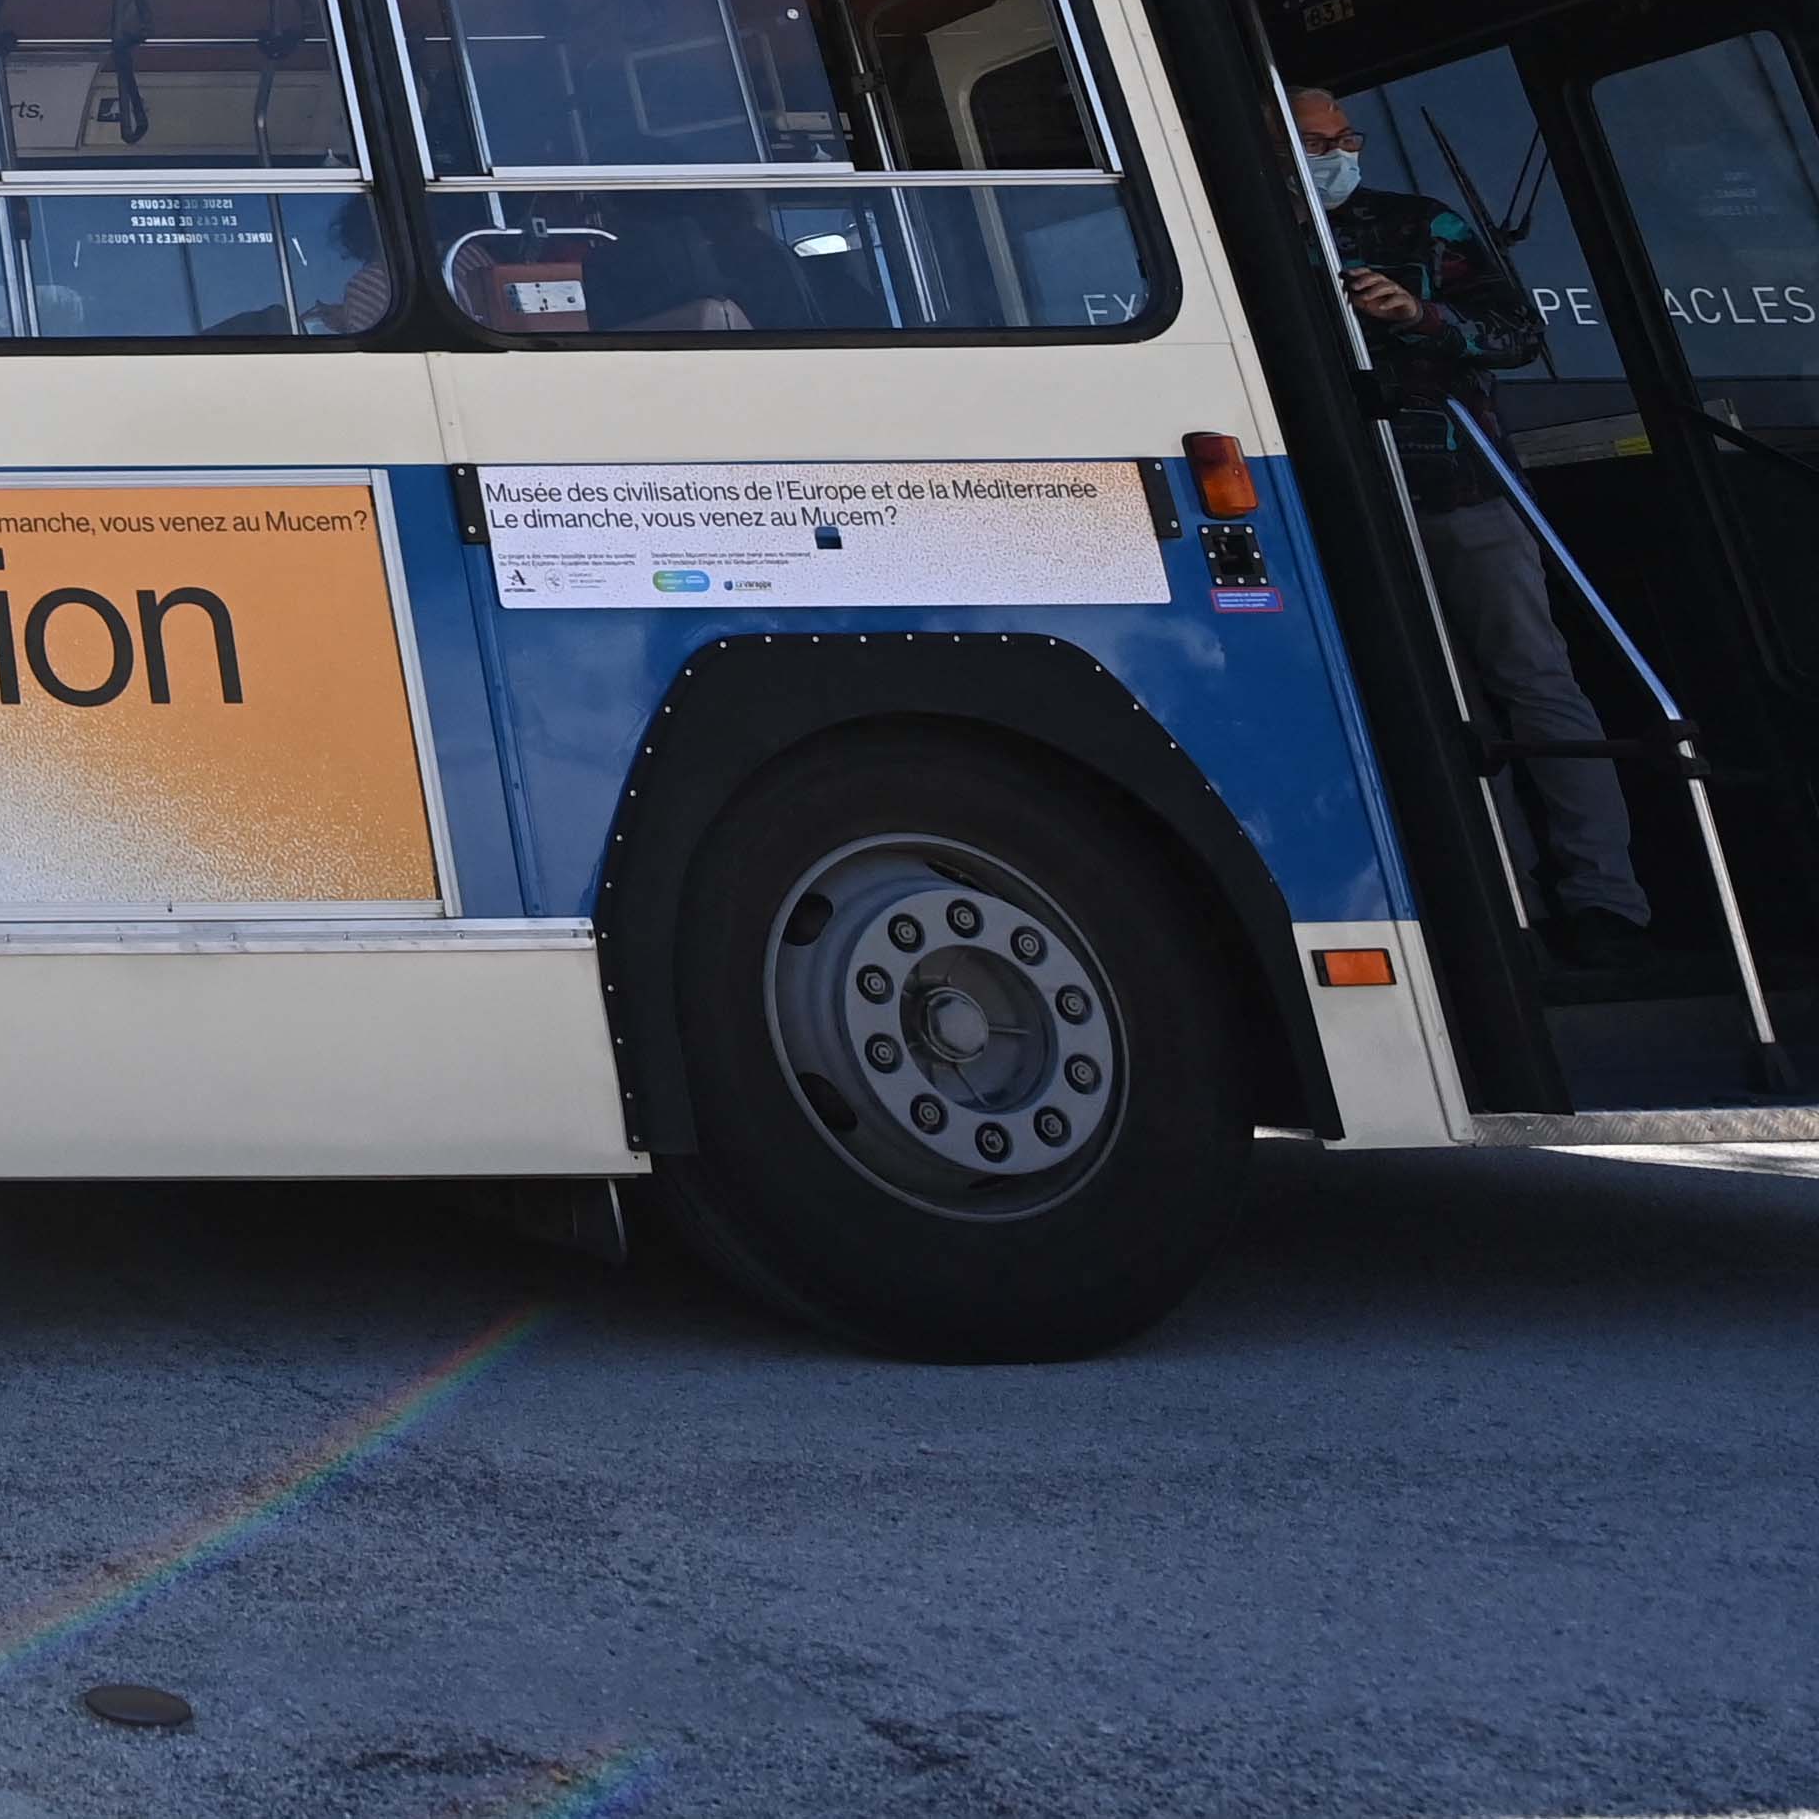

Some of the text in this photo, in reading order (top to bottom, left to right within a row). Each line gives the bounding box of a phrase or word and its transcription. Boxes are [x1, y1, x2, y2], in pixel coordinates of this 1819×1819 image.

[485, 476, 1098, 506] Musée des civilisations de l'Europe et de la Méditerranée
[100, 516, 155, 533] vous
[159, 516, 228, 532] venez
[233, 516, 261, 532] au
[490, 509, 519, 529] Le
[523, 508, 639, 532] dimanche,
[644, 512, 696, 528] vous
[698, 511, 766, 528] venez
[770, 511, 798, 527] au
